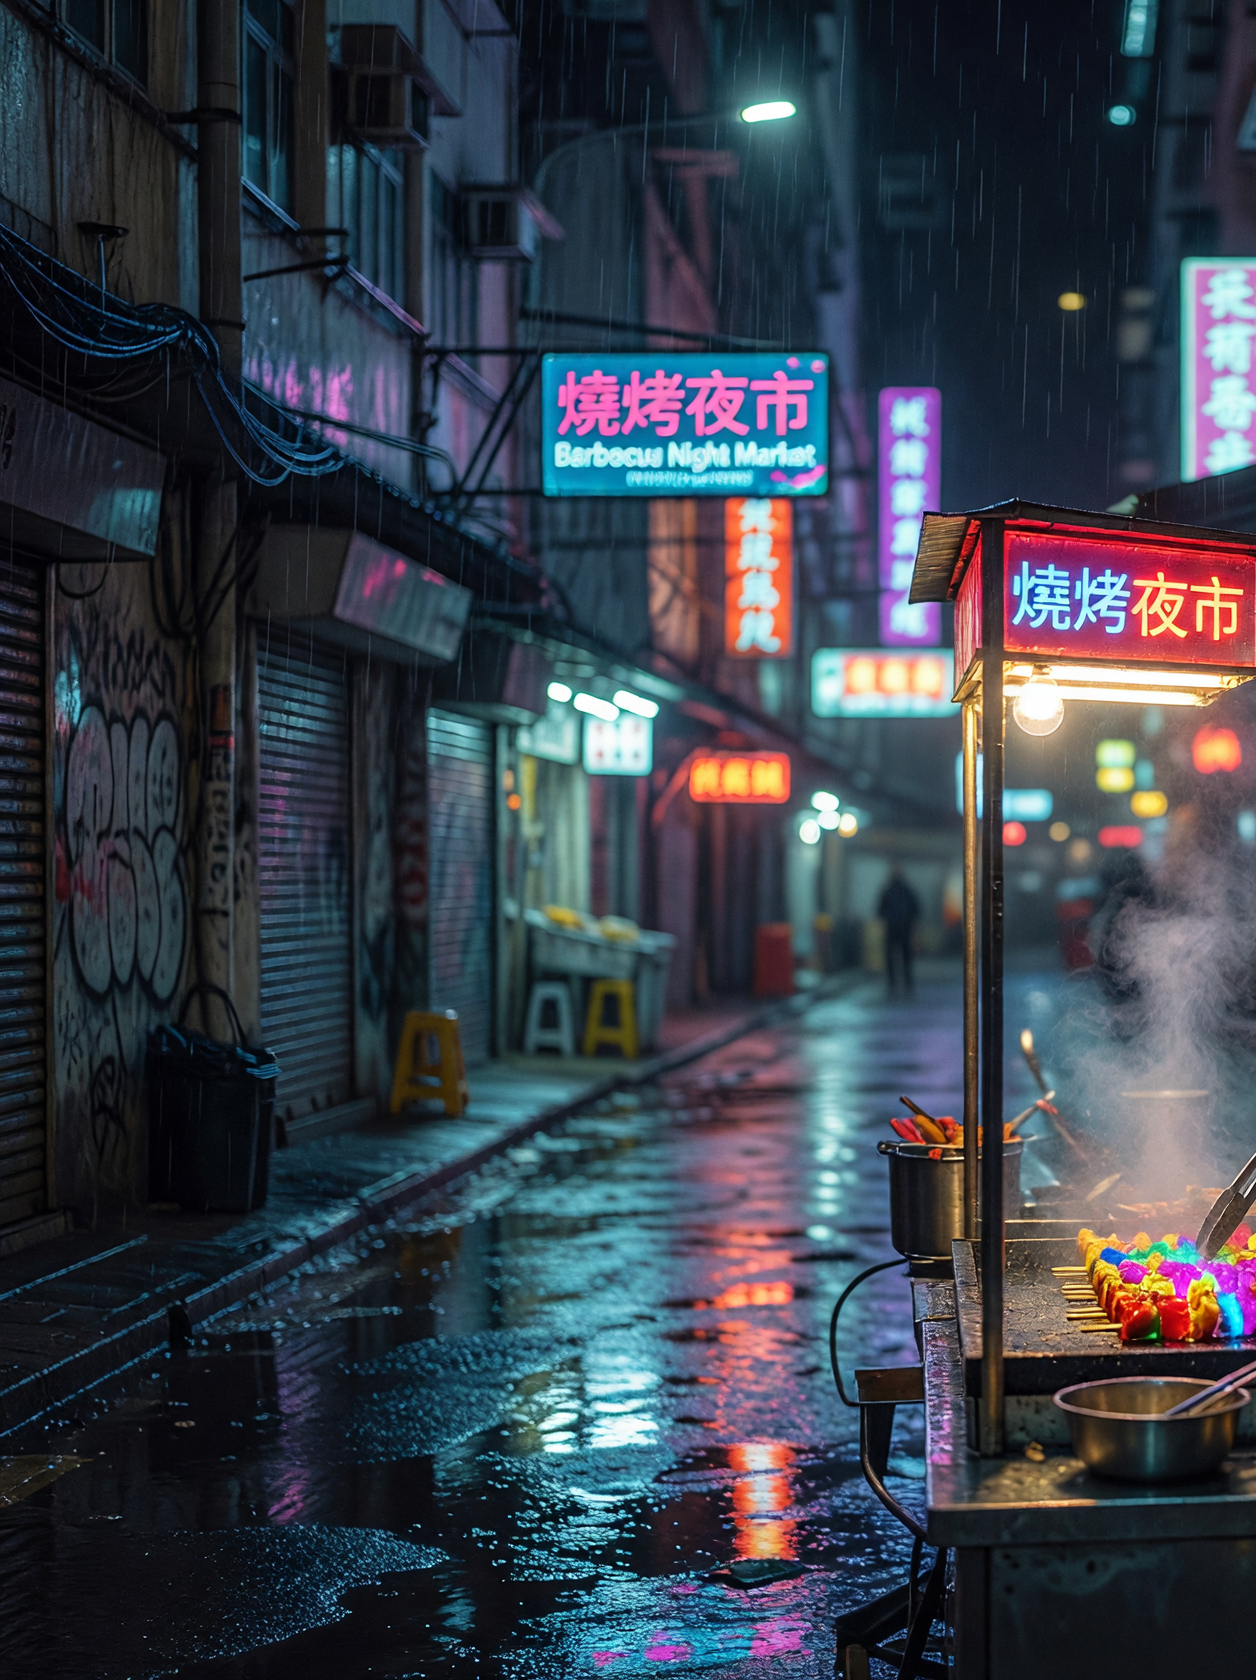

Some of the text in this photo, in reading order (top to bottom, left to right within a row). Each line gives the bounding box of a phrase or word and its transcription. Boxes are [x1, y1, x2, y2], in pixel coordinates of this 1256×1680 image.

[557, 369, 814, 437] 燒烤夜市
[667, 440, 731, 473] Night
[1011, 560, 1245, 642] 燒烤夜市
